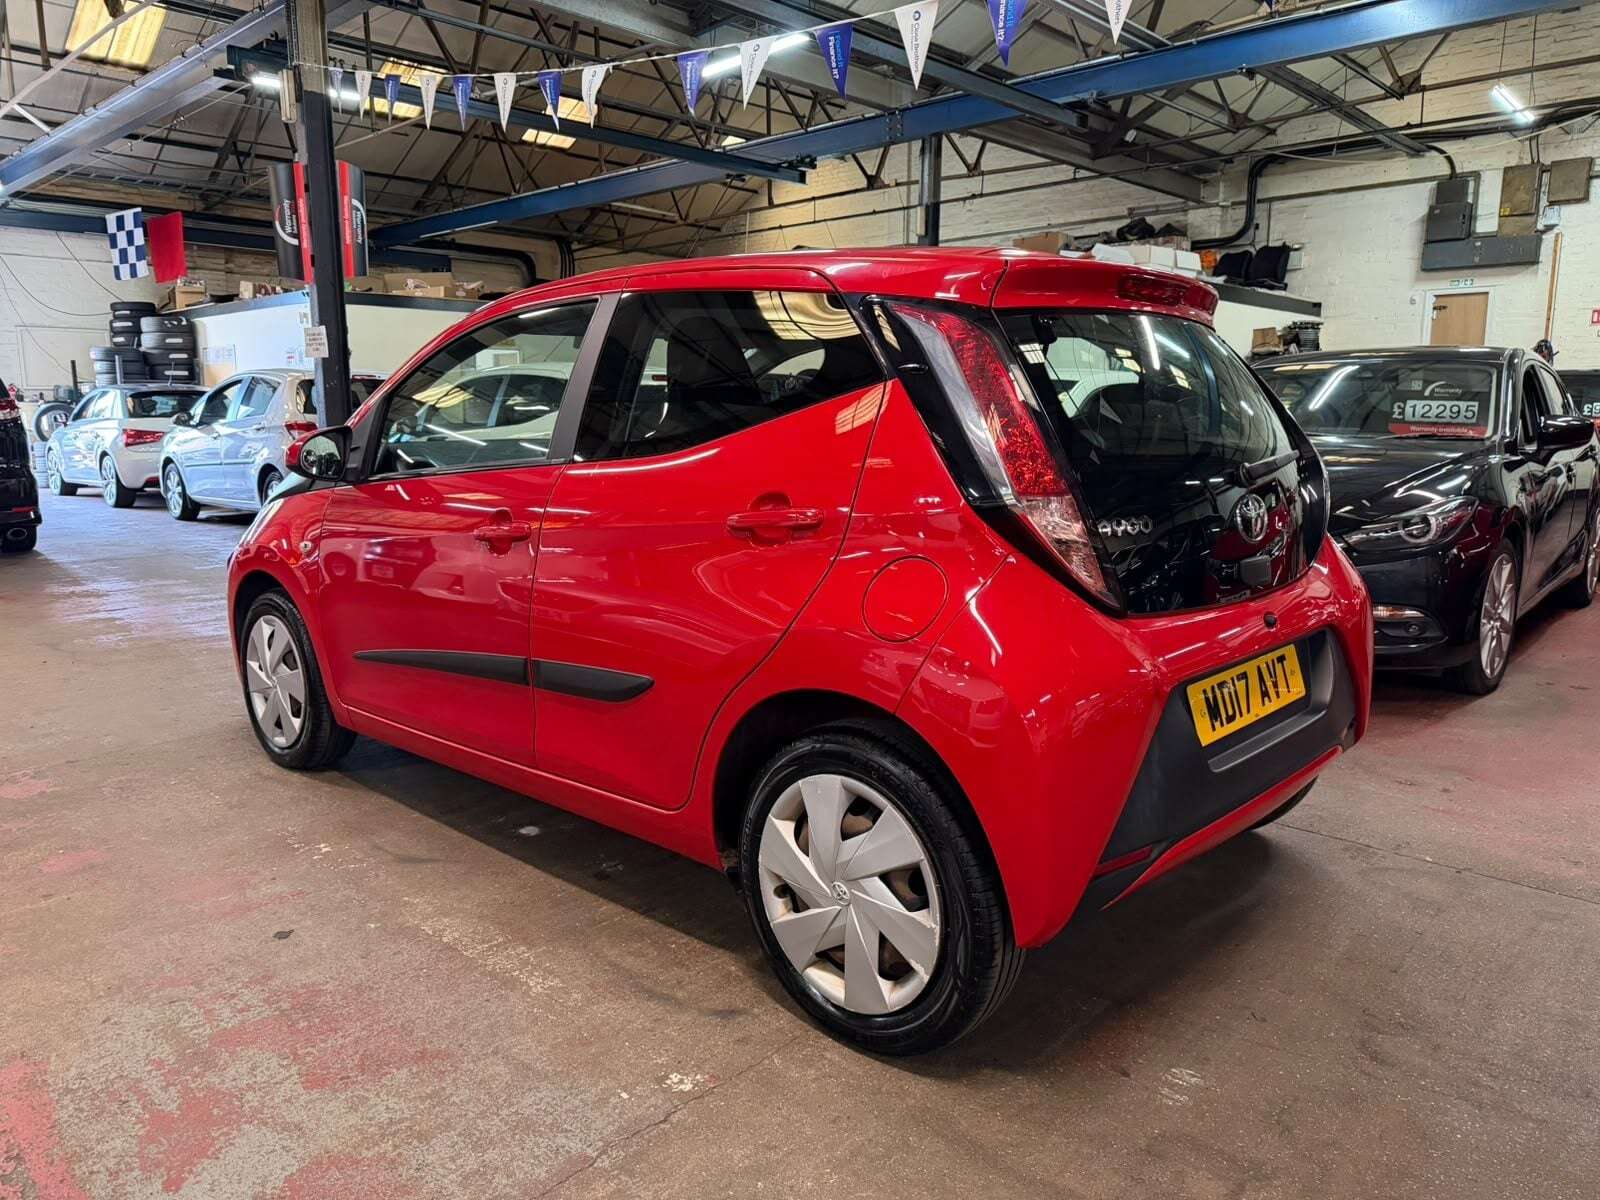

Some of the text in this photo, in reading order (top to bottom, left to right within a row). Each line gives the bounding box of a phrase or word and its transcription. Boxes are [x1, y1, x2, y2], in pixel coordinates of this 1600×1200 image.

[828, 36, 837, 68] Finance
[283, 199, 292, 233] Warranty
[1202, 653, 1290, 732] MD17 AVT
